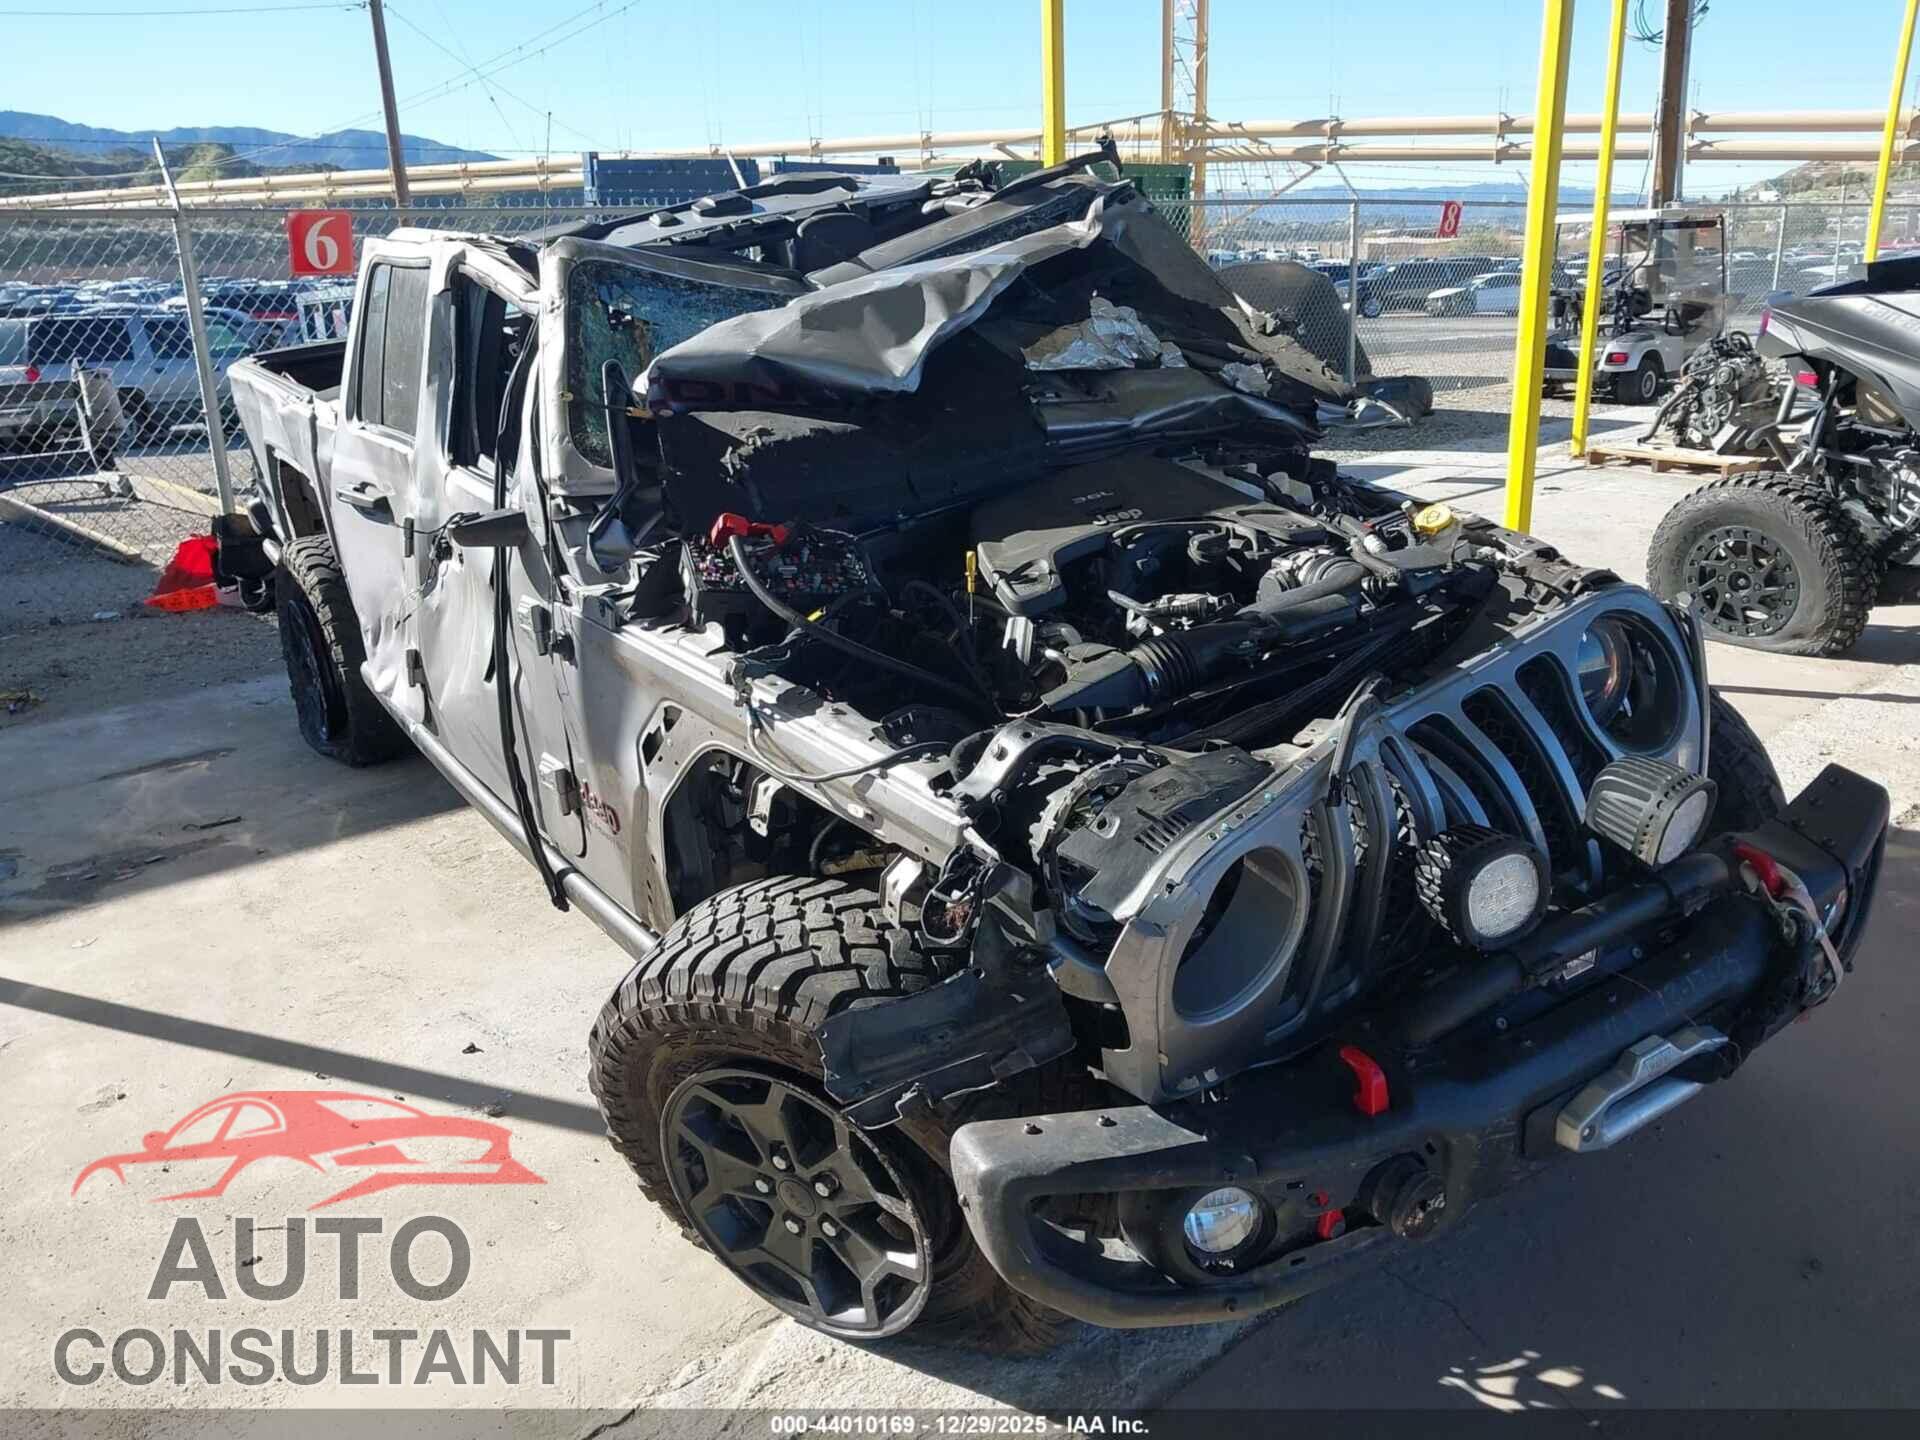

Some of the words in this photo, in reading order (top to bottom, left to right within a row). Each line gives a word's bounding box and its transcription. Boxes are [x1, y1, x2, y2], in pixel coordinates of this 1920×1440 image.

[1444, 204, 1458, 233] 8
[304, 216, 338, 270] 6
[1092, 508, 1143, 526] Jeep
